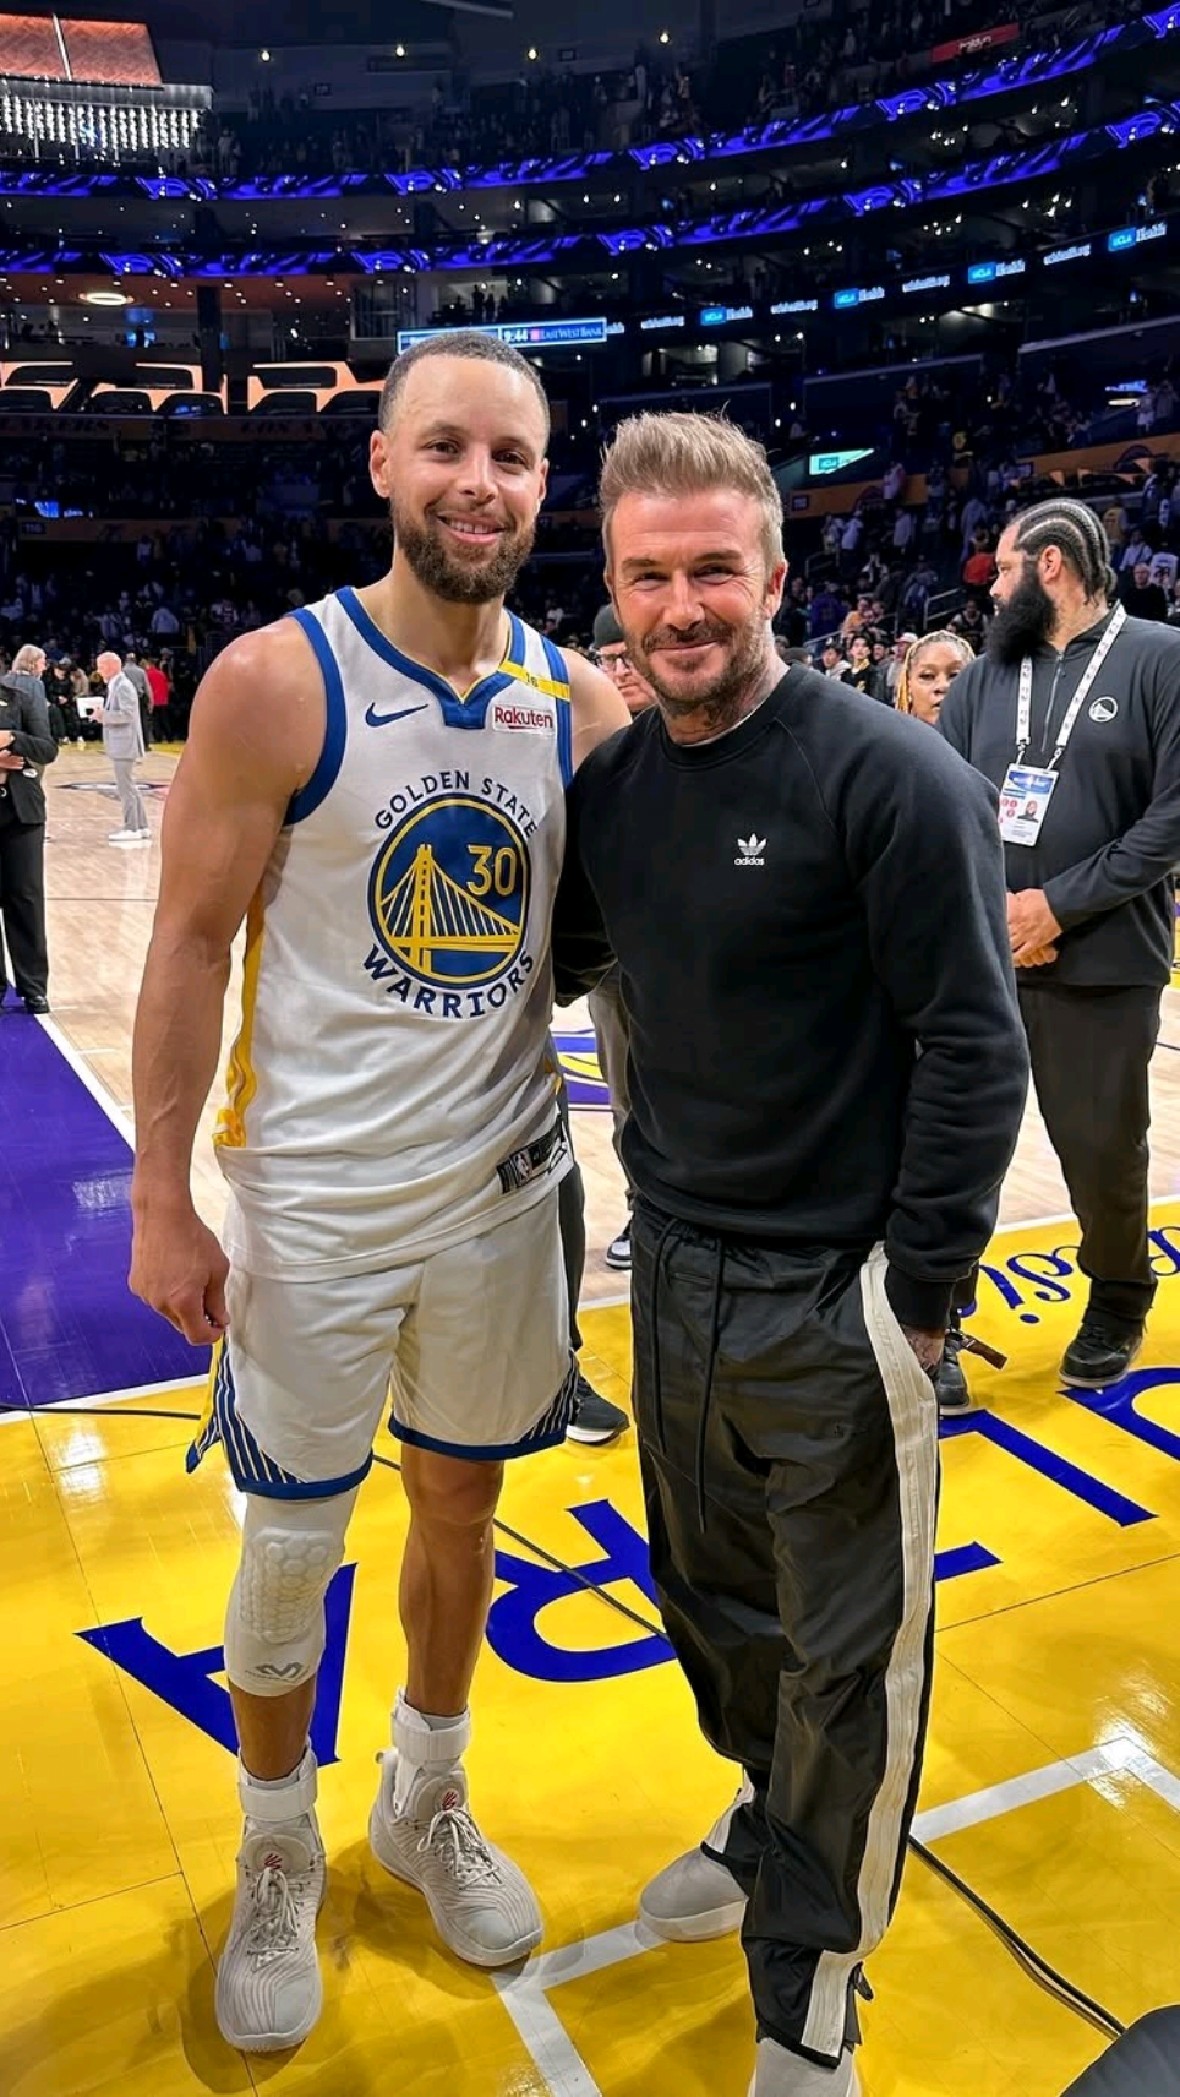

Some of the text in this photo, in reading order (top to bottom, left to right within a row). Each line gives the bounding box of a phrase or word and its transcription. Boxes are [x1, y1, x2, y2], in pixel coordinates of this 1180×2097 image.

[495, 706, 553, 728] Rakuten
[375, 770, 538, 840] GOLDEN STATE
[467, 844, 518, 896] 30
[733, 856, 765, 866] adidas
[364, 944, 535, 1019] WARRIORS
